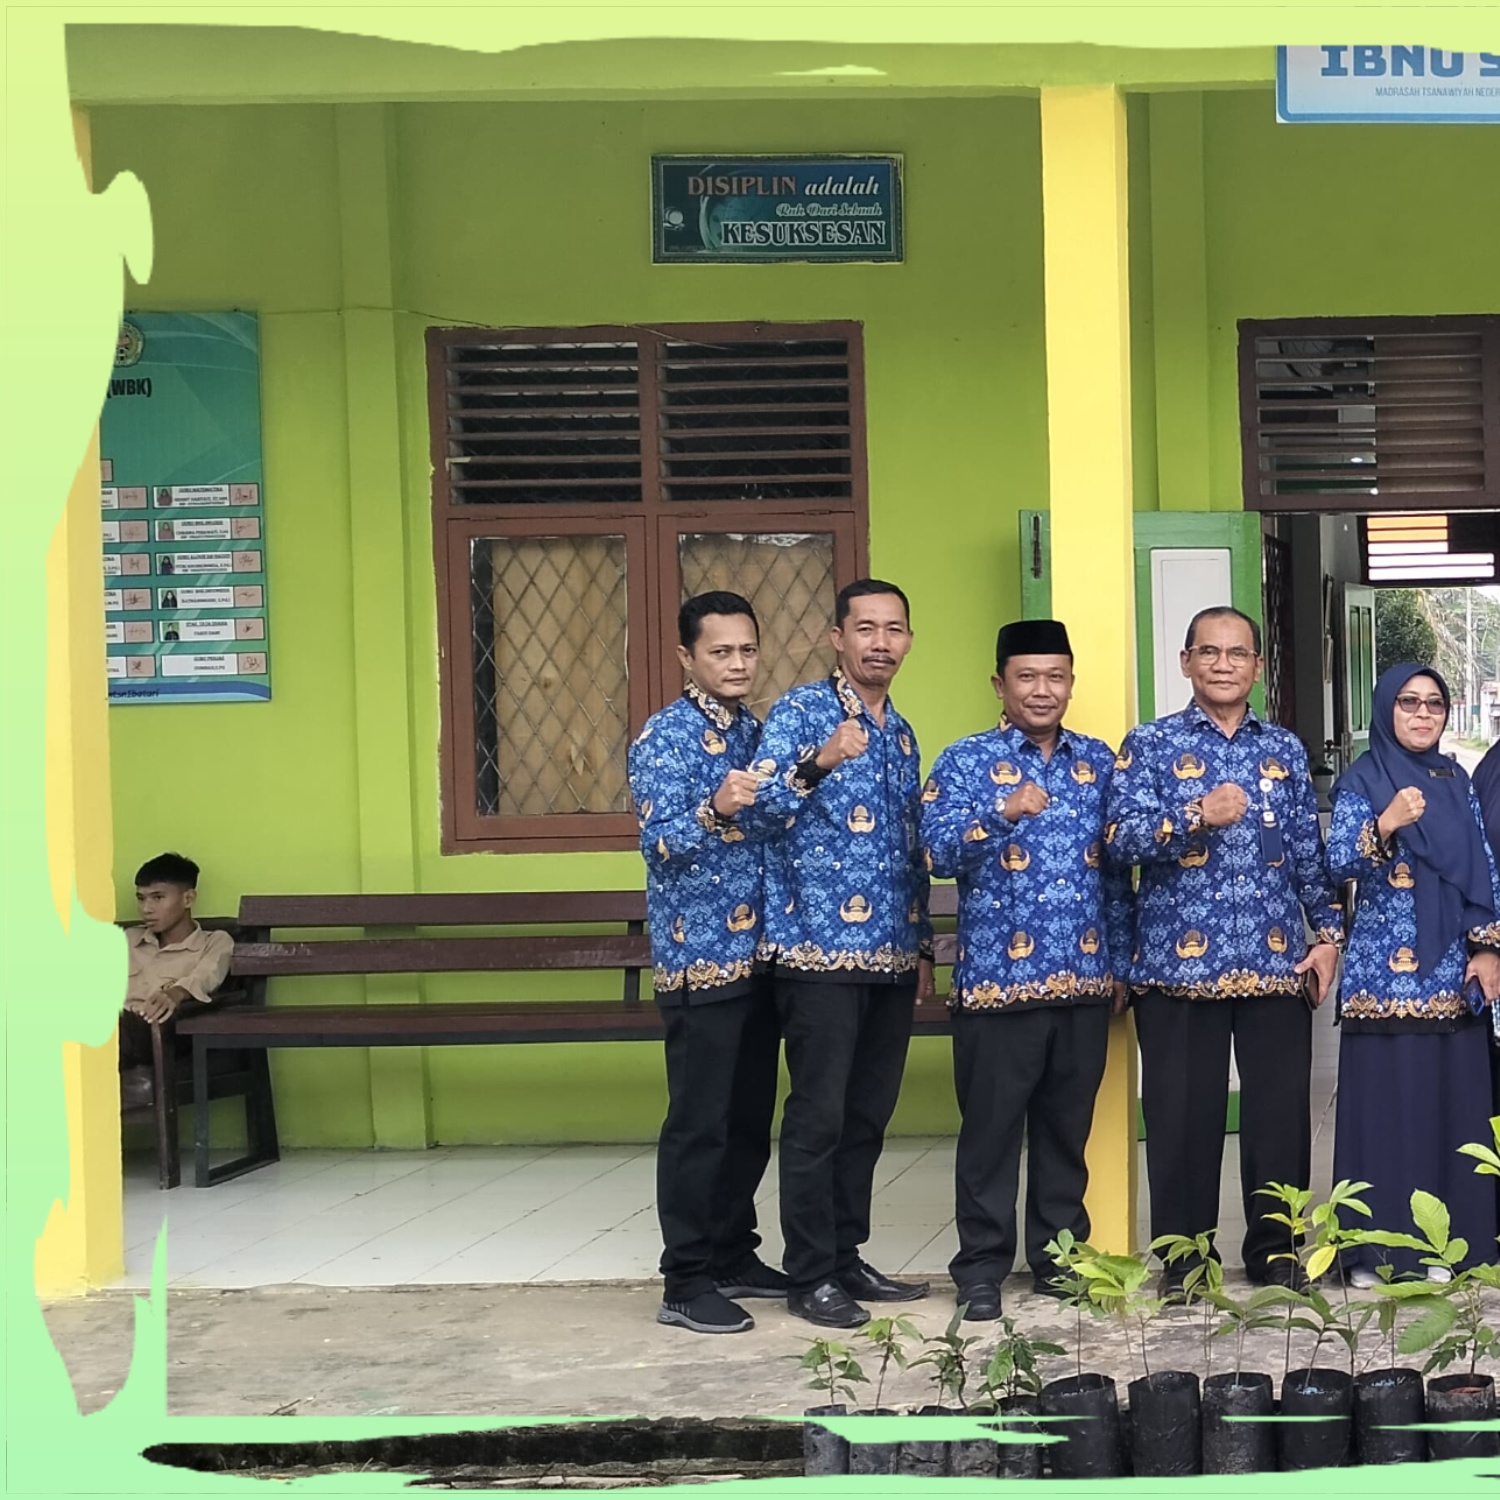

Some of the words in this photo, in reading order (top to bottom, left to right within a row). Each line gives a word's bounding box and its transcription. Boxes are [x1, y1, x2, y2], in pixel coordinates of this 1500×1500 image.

[1321, 44, 1464, 77] IBNU
[1375, 87, 1420, 97] MADRASAH
[1422, 87, 1474, 97] TSANAWIYAH
[688, 176, 796, 196] DISIPLIN
[804, 175, 880, 196] adalah
[806, 203, 838, 216] Dari
[721, 221, 886, 246] KESUKSESAN
[107, 377, 152, 399] (WBK)
